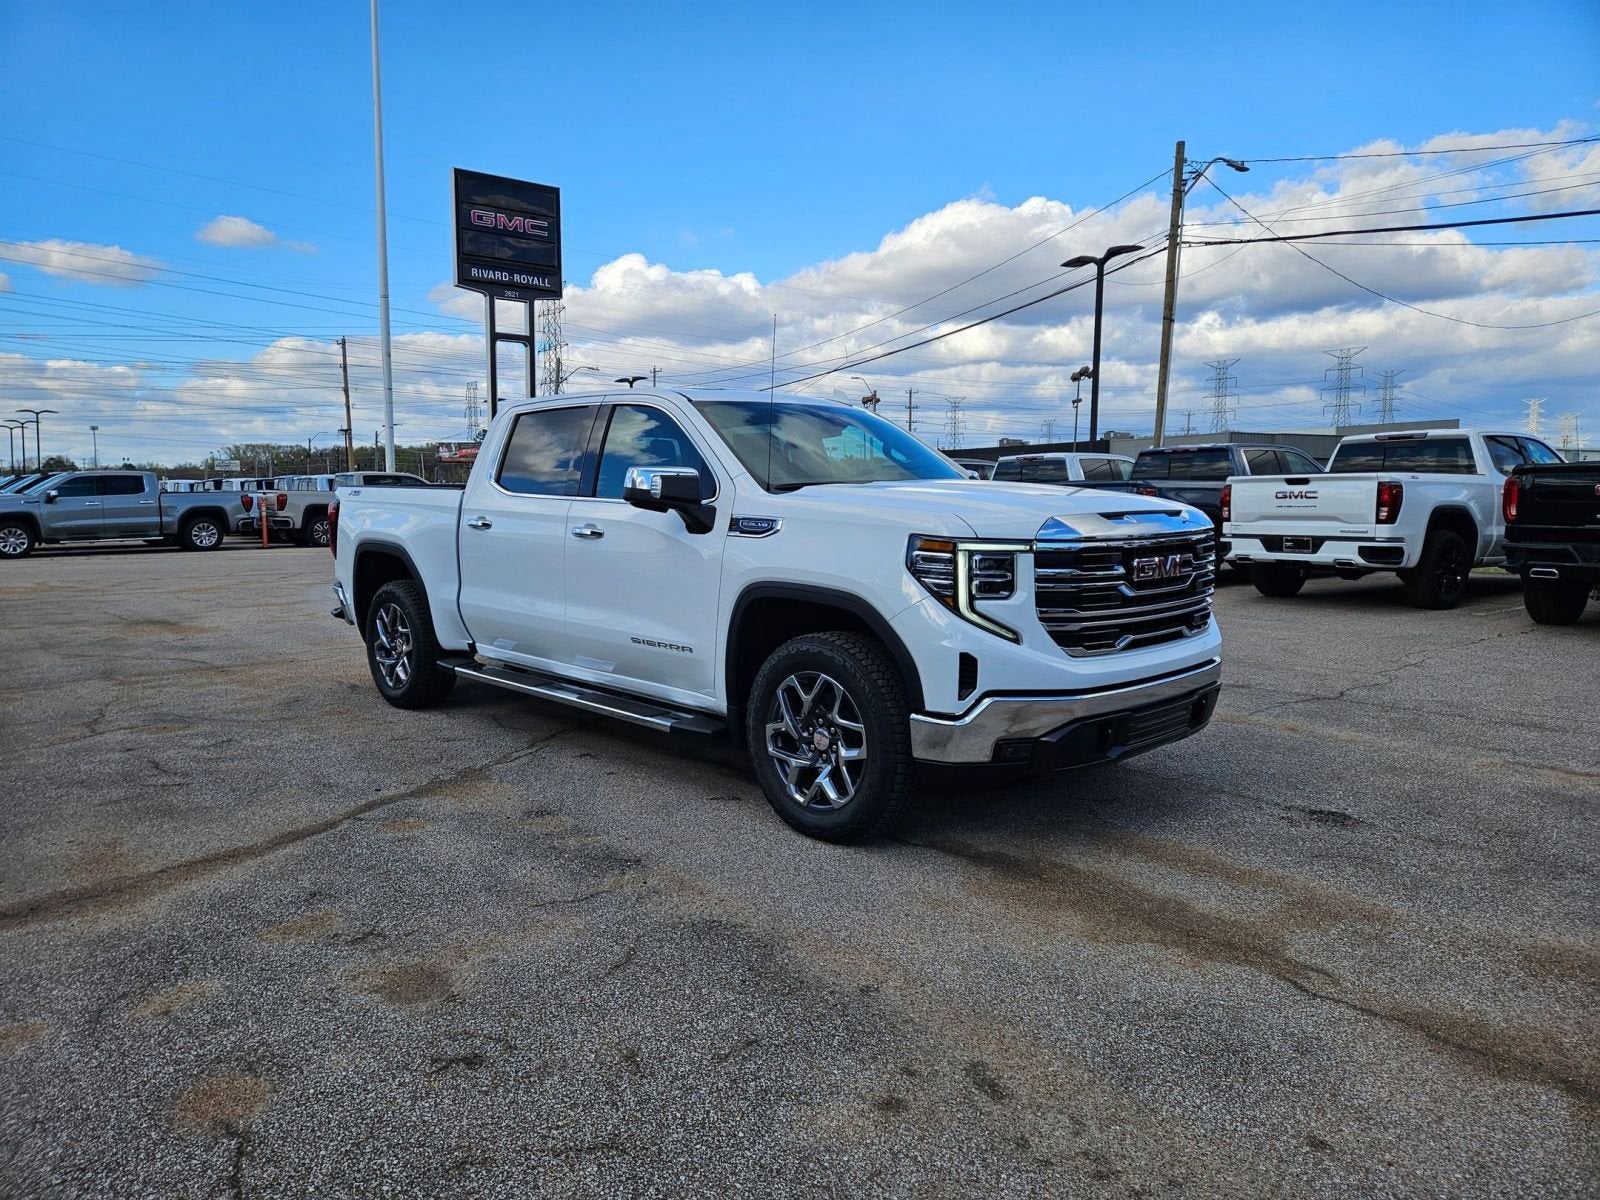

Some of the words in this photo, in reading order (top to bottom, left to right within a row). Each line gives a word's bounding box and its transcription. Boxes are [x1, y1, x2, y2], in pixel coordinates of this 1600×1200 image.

[470, 209, 548, 236] GMC
[471, 267, 551, 287] RIVARD-ROYALL
[1275, 490, 1318, 499] GMC
[1133, 553, 1193, 581] GMC
[630, 636, 693, 653] SIERRA
